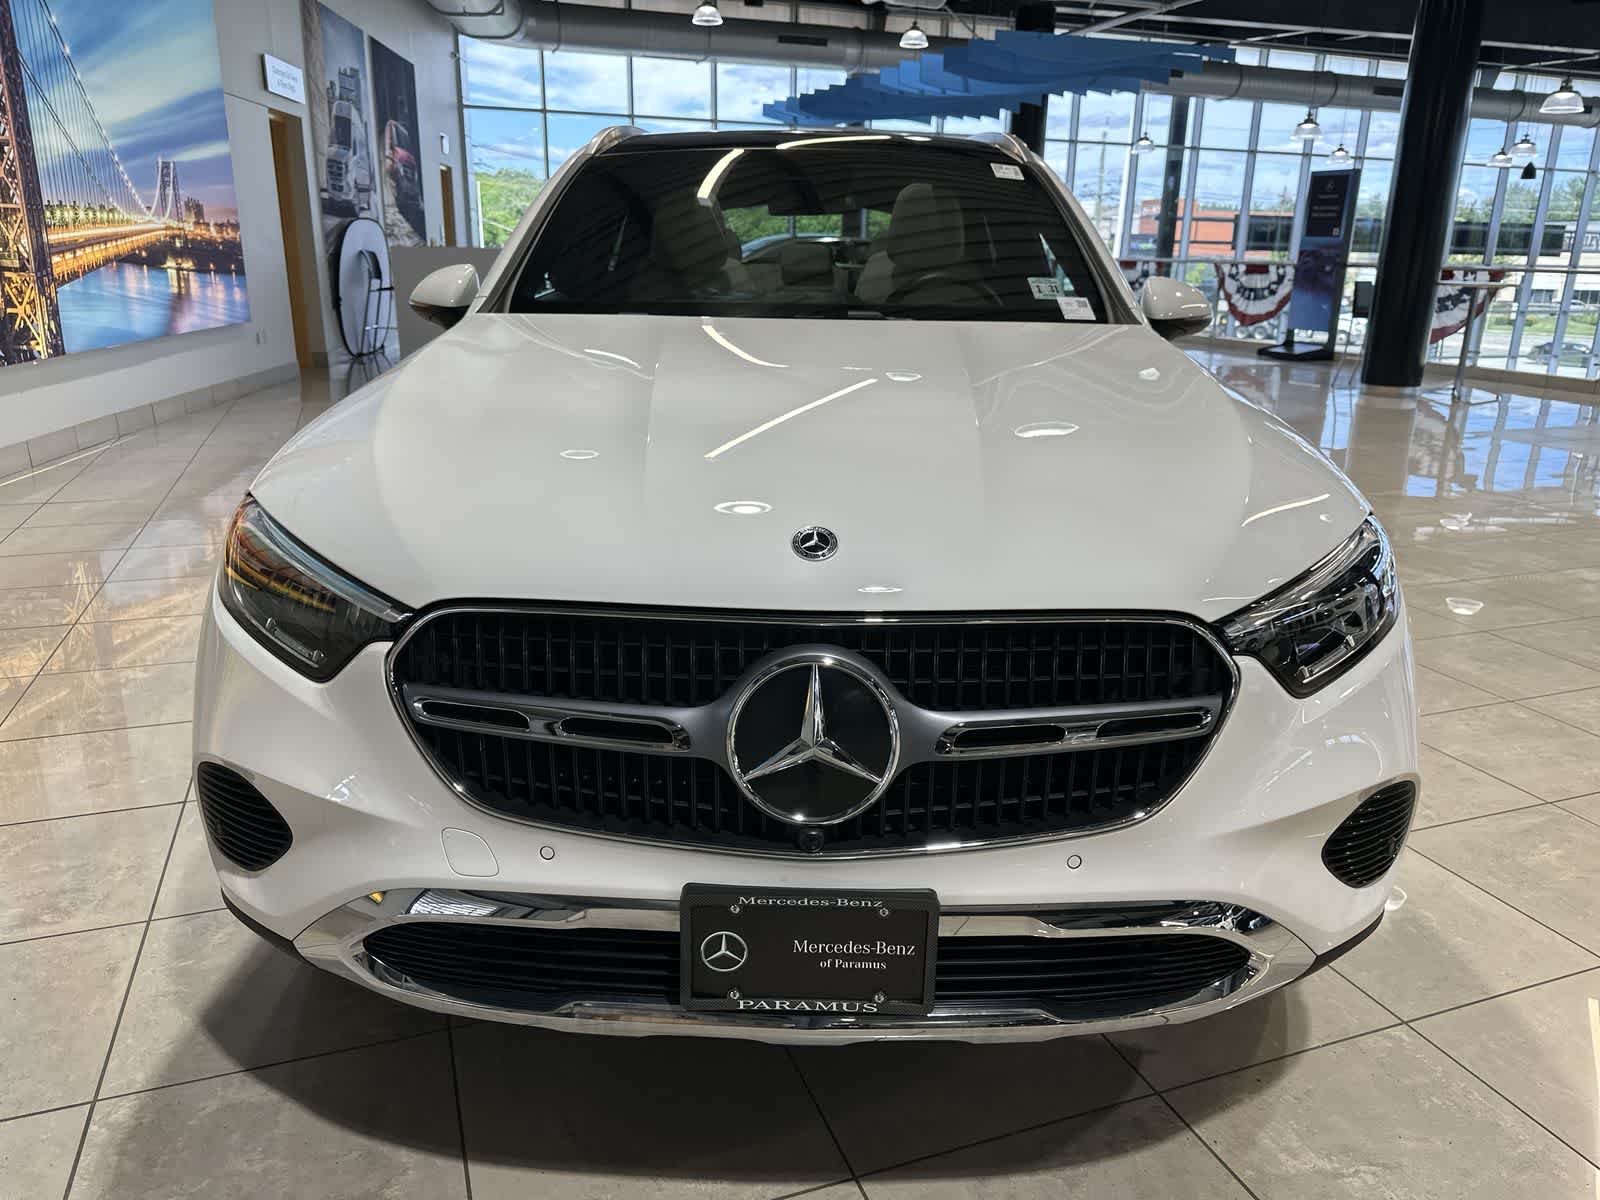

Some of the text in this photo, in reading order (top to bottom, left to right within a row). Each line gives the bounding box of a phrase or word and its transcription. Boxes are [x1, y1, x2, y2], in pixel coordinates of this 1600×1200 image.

[737, 896, 883, 907] Mercedes-Benz
[793, 940, 916, 956] Mercedes-Benz
[819, 958, 888, 969] of Paramus
[737, 1000, 878, 1013] PARAMUS
